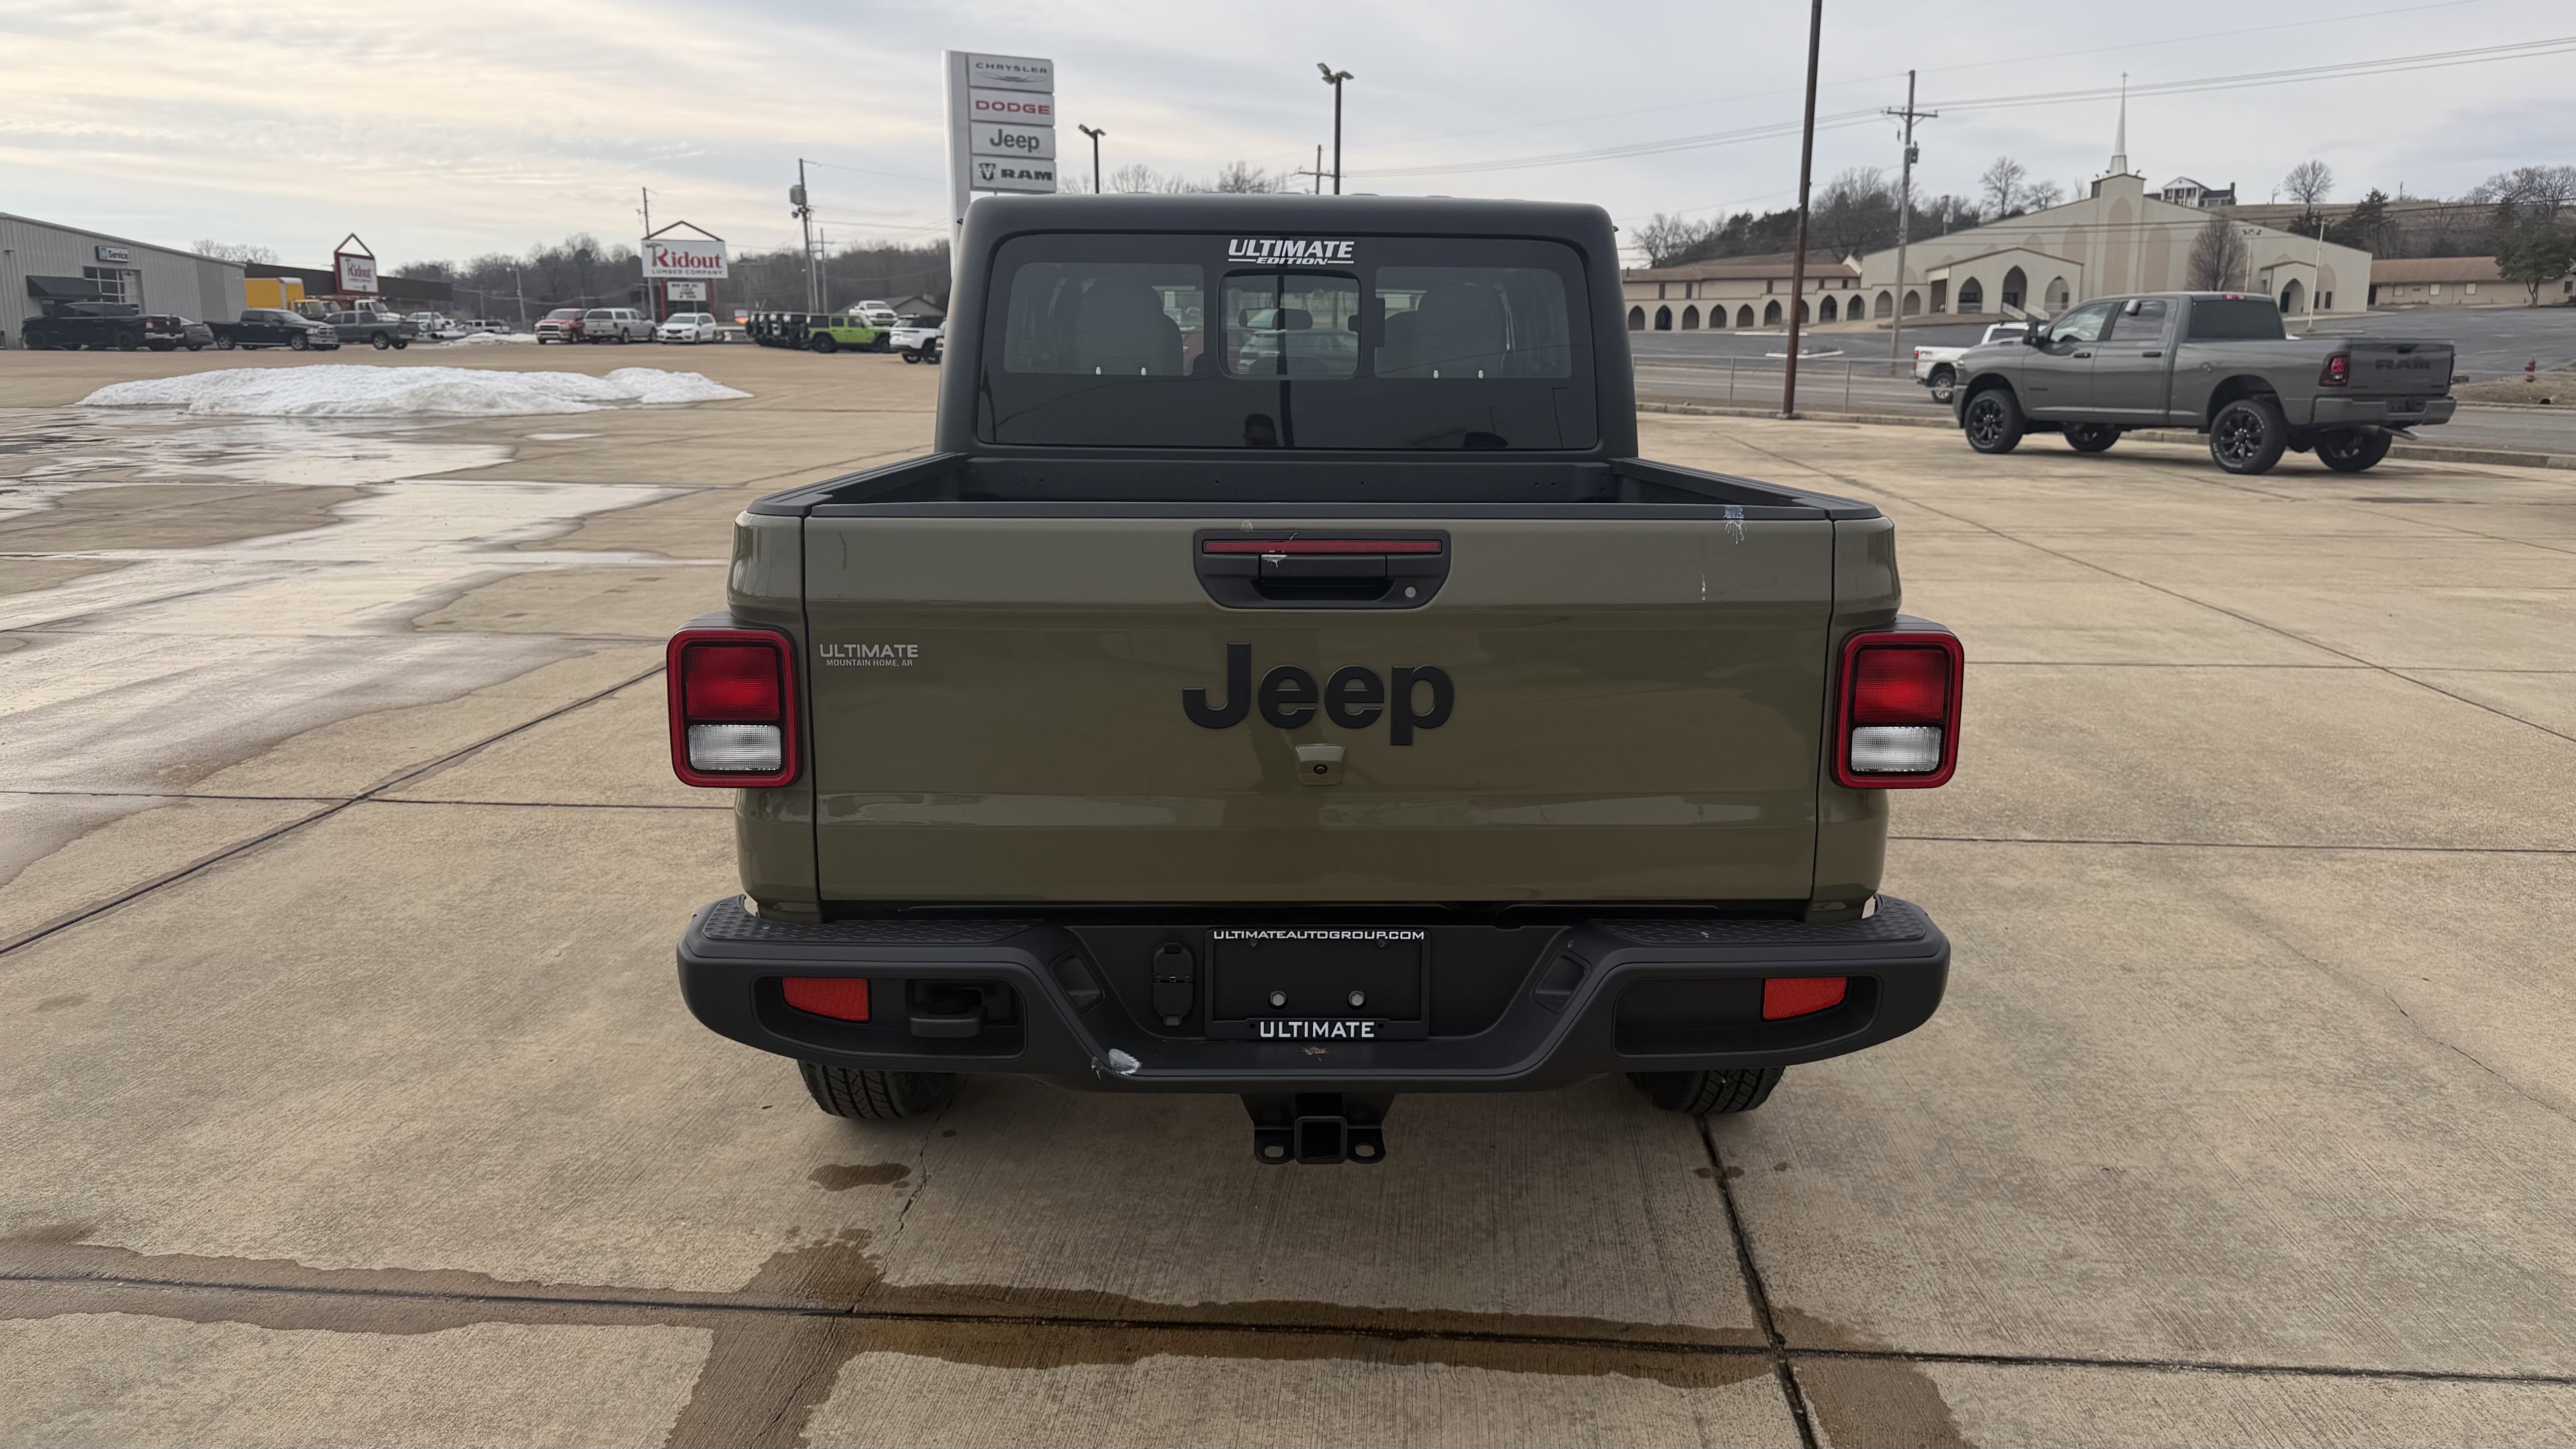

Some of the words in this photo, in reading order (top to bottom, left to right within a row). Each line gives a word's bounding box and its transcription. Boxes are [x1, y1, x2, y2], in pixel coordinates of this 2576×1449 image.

[975, 63, 1047, 74] CHRYSLER
[975, 100, 1050, 115] DODGE
[989, 129, 1040, 152] Jeep
[1001, 169, 1052, 181] RAM
[108, 249, 128, 260] Service
[1228, 239, 1355, 258] ULTIMATE
[645, 243, 722, 268] Ridout
[1256, 257, 1329, 265] EDITION
[2375, 359, 2431, 369] RAM
[819, 644, 918, 658] ULTIMATE
[873, 659, 899, 667] HOME,
[1182, 642, 1454, 745] Jeep
[1213, 930, 1424, 940] ULTIMATEAUTOGROUP.COM
[1260, 1021, 1374, 1038] ULTIMATE
